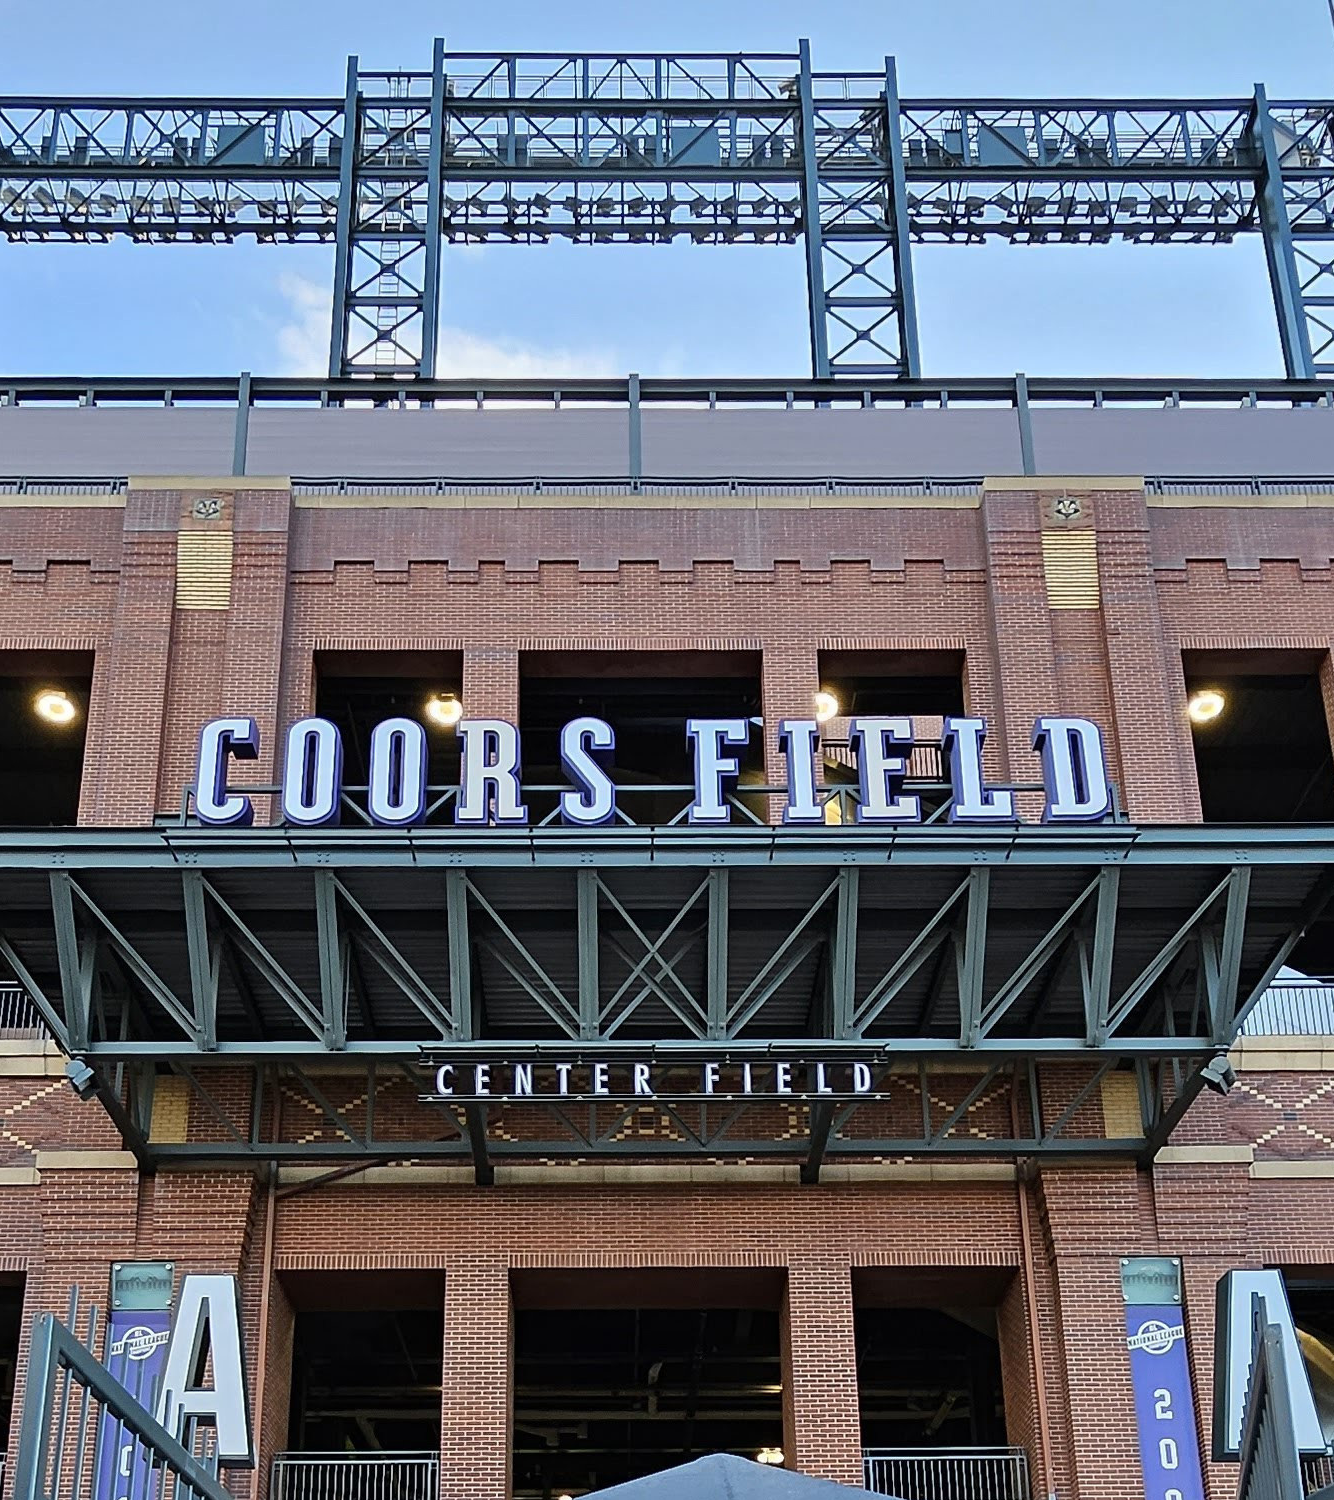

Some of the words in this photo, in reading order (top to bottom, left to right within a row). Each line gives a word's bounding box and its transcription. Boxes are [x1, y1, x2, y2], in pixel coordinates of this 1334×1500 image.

[194, 717, 616, 826] COORS
[687, 717, 1115, 825] FIELD
[435, 1063, 655, 1095] CENTER
[704, 1063, 872, 1094] FIELD
[156, 1274, 254, 1463] A
[1159, 1328, 1183, 1340] LEAGUE
[1217, 1269, 1329, 1457] A
